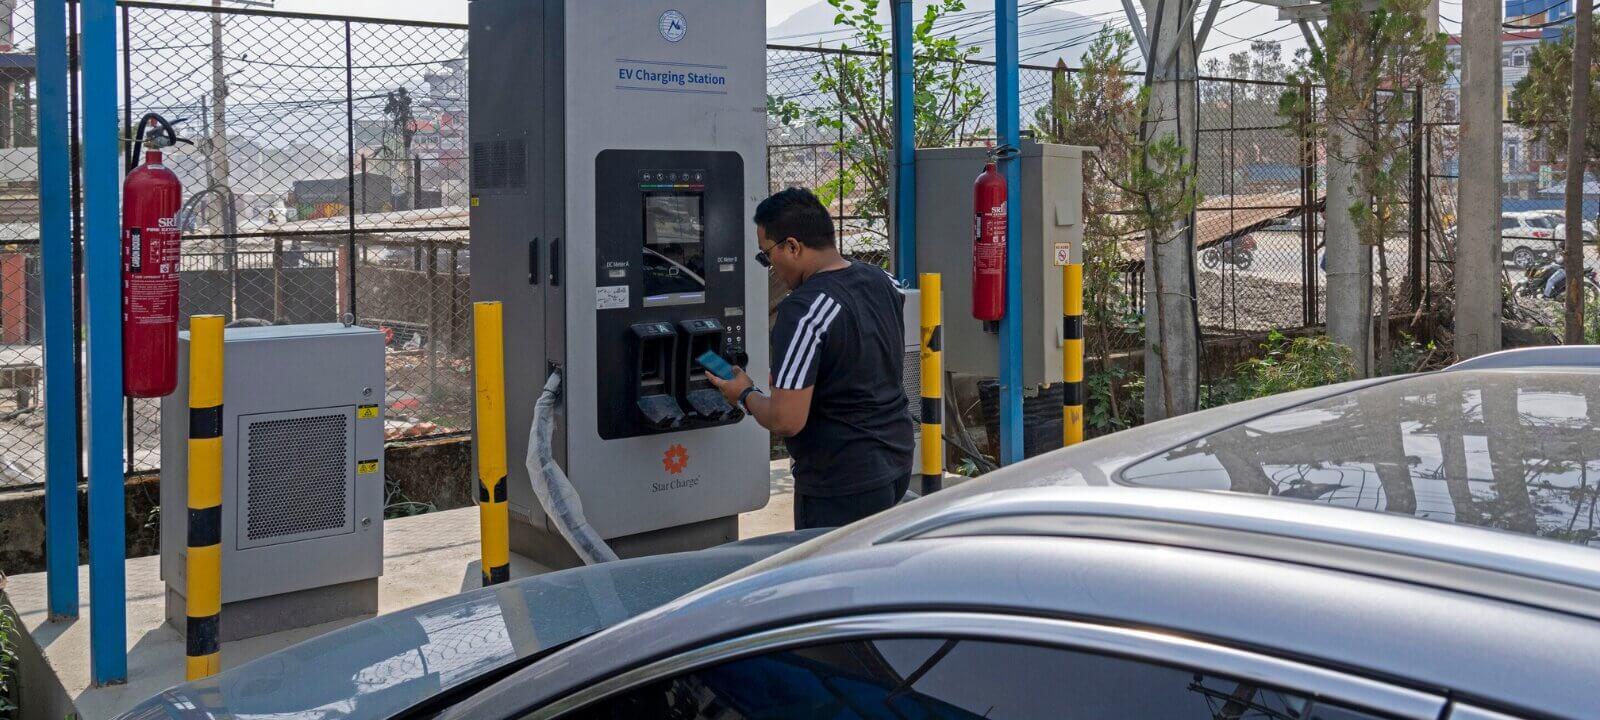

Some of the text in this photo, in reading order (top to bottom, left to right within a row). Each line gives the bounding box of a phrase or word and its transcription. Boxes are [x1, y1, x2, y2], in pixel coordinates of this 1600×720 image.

[619, 68, 726, 86] EV Charging Station
